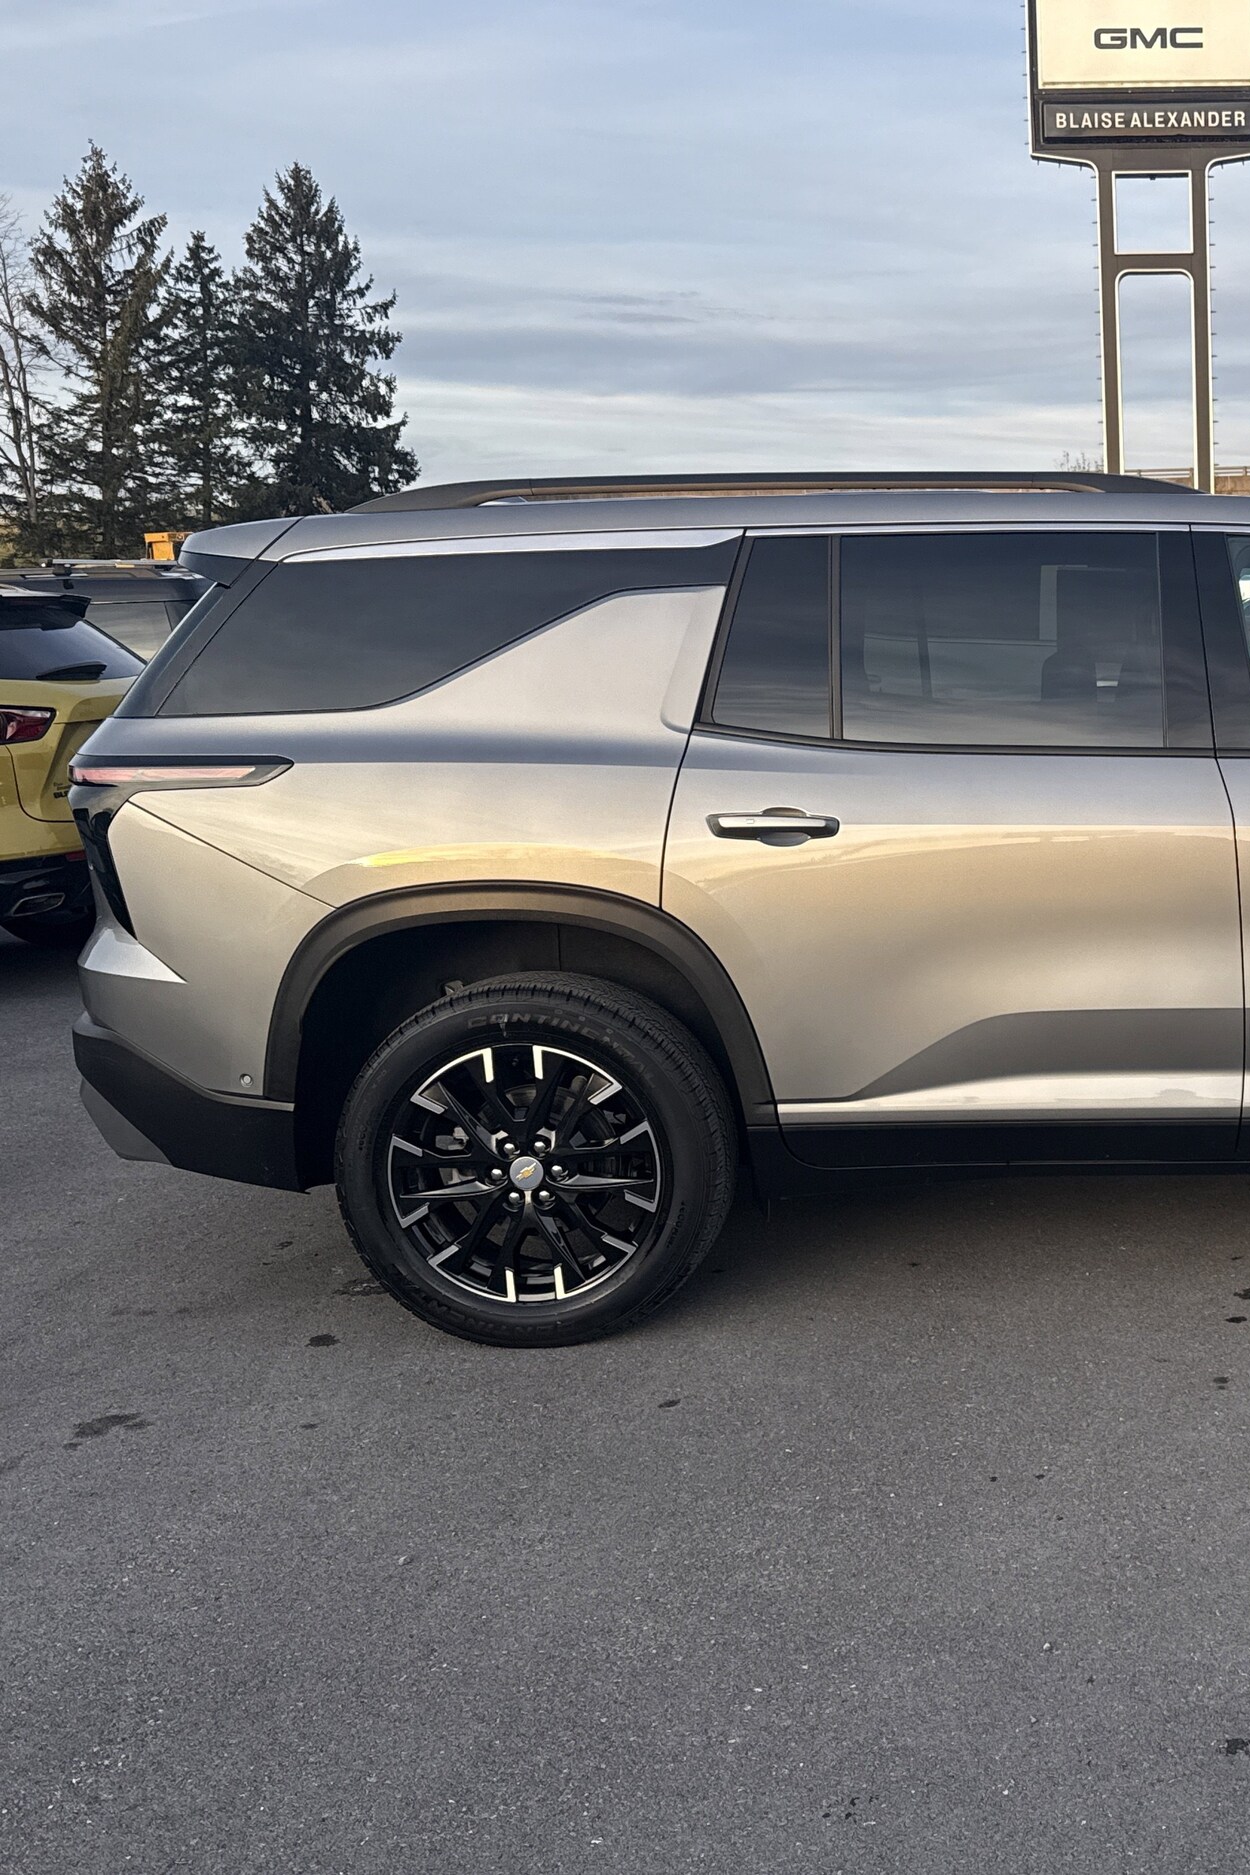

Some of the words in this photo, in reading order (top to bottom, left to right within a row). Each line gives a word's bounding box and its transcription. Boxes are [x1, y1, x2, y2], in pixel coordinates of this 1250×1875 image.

[1093, 27, 1203, 50] GMC
[1055, 112, 1125, 129] BLAISE
[1130, 110, 1246, 128] ALEXANDER
[467, 1012, 658, 1089] CONTINENTAL
